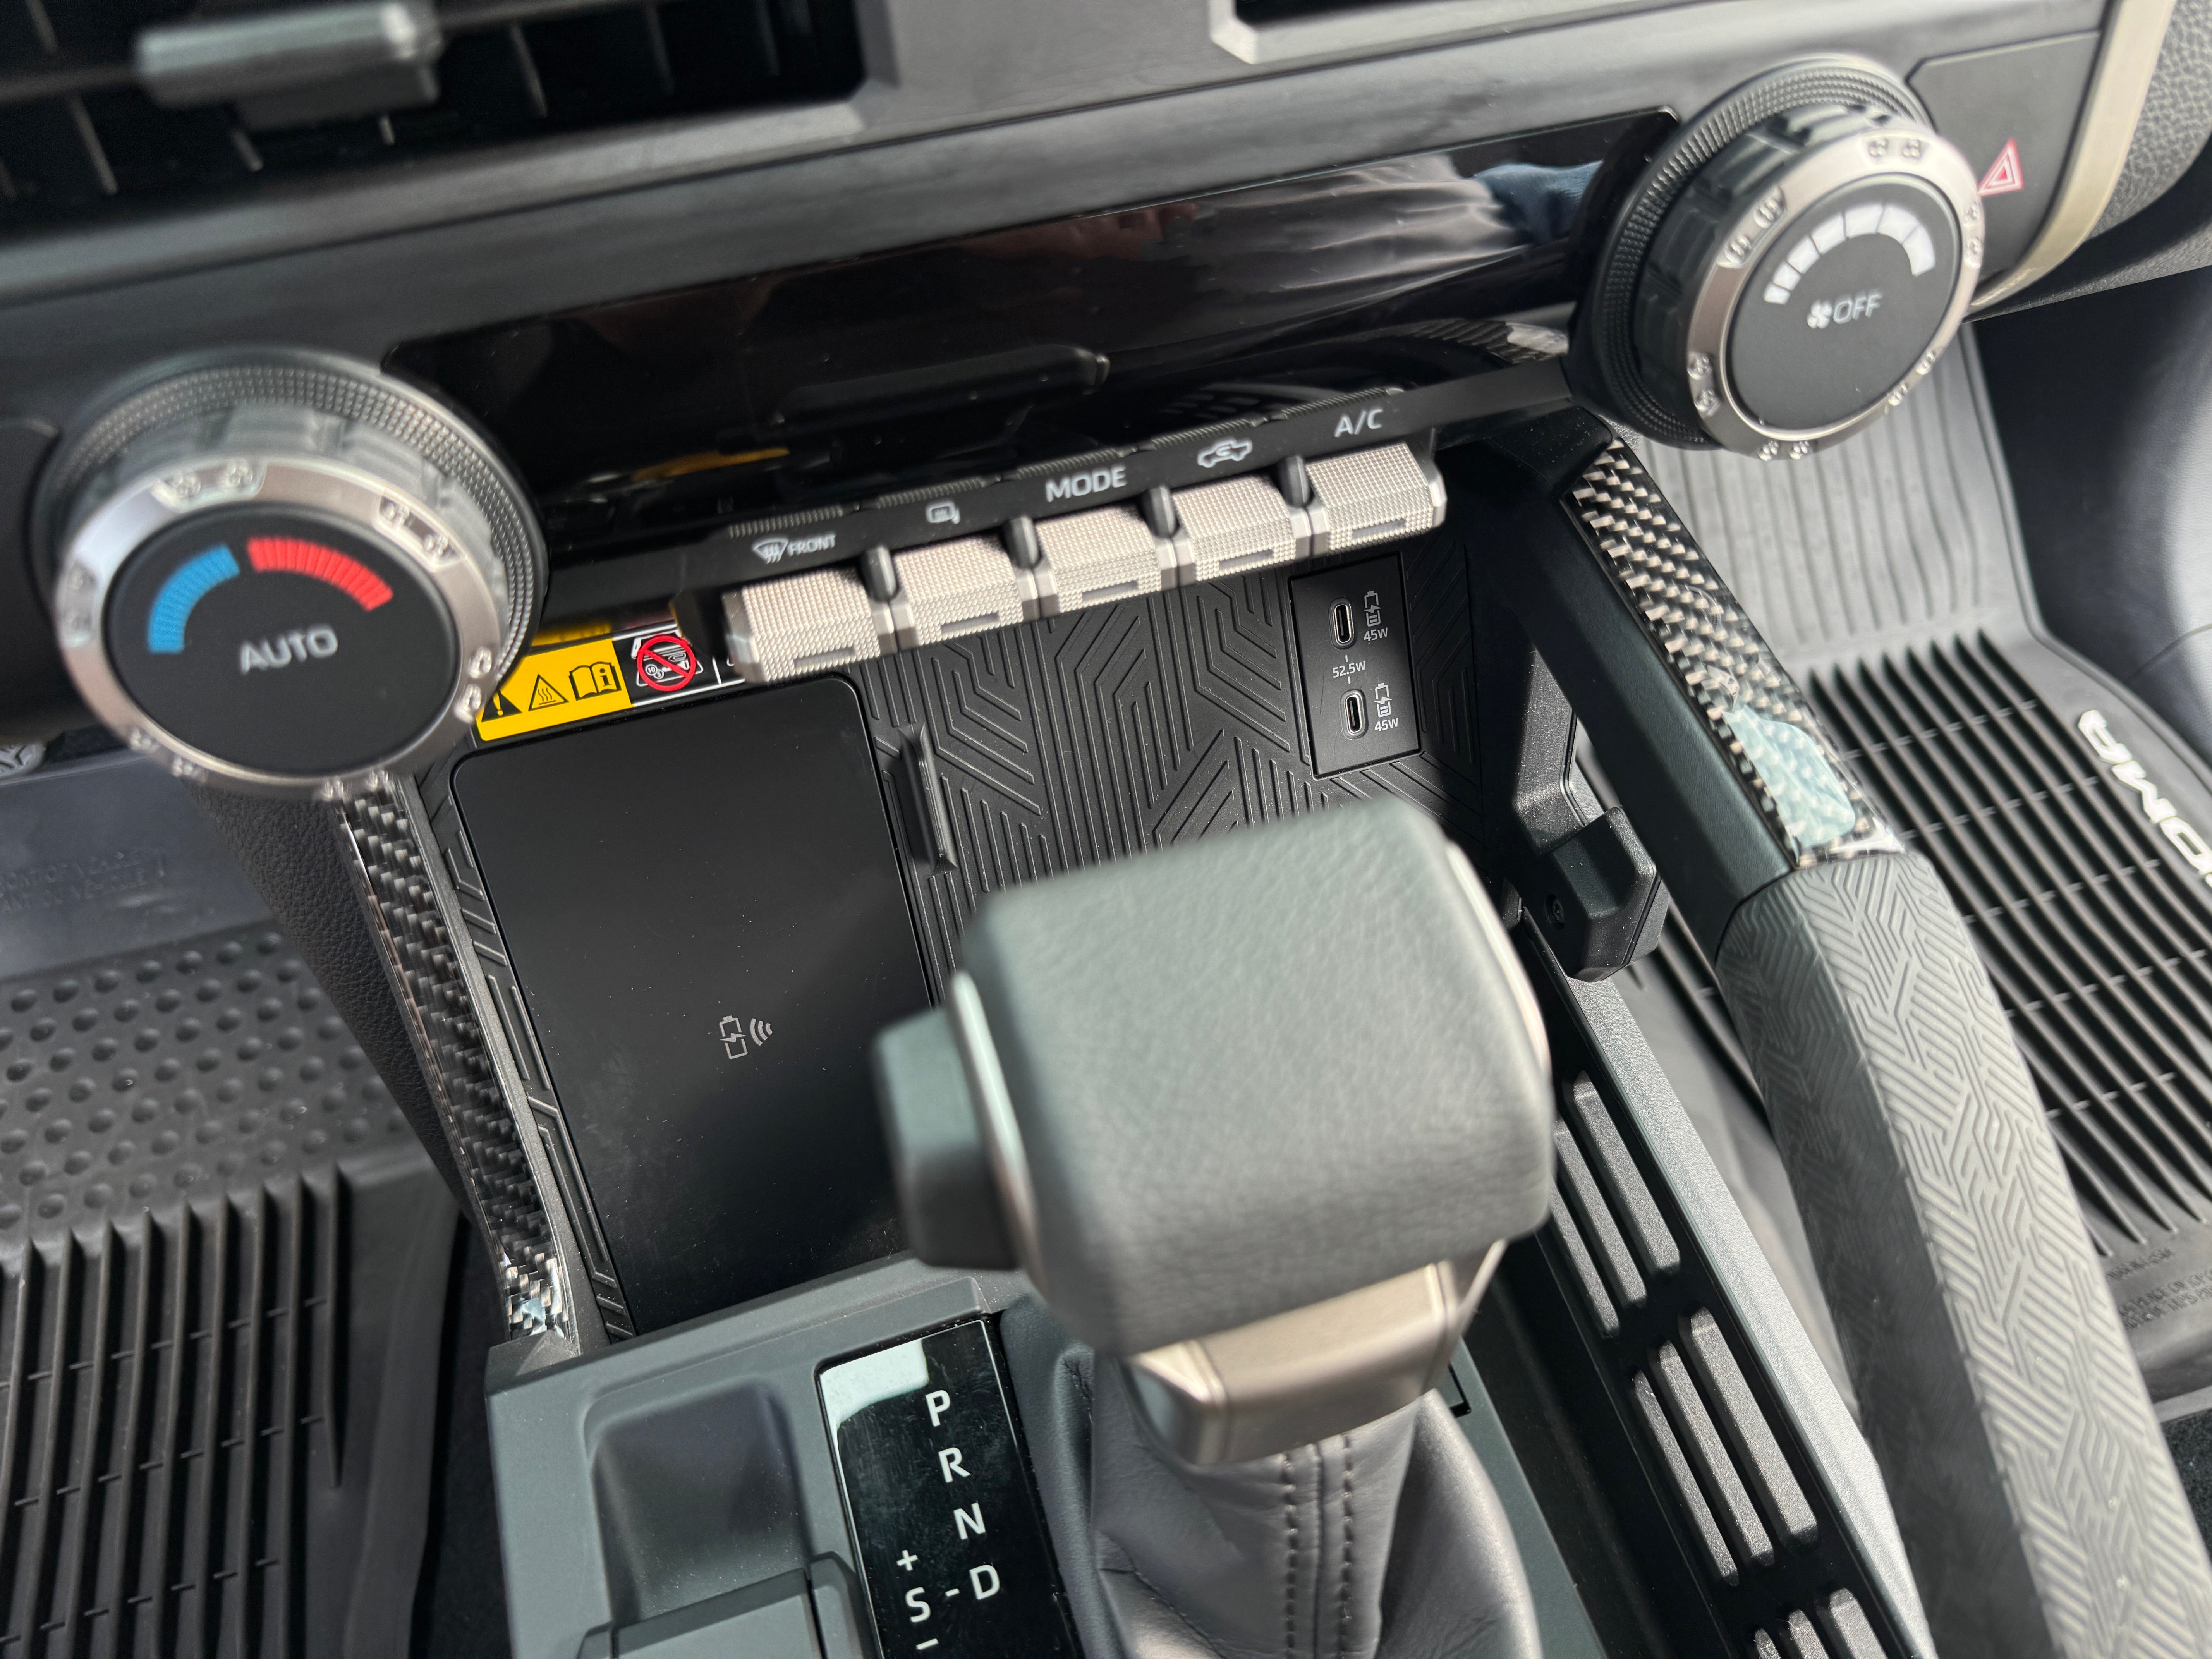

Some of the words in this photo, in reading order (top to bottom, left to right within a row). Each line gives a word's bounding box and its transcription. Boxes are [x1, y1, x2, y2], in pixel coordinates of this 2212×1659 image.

[1832, 290, 1884, 324] OFF
[1334, 407, 1383, 437] A/C
[1045, 465, 1127, 502] MODE
[788, 533, 836, 556] FRONT
[239, 625, 339, 674] AUTO
[1364, 627, 1388, 642] 45W
[1332, 660, 1366, 678] 52.5W
[1374, 717, 1398, 732] 45W
[2078, 709, 2212, 888] OMA
[925, 1389, 950, 1427] P
[938, 1447, 971, 1483] R
[954, 1502, 986, 1540] N
[905, 1587, 931, 1623] S
[969, 1565, 1000, 1600] D
